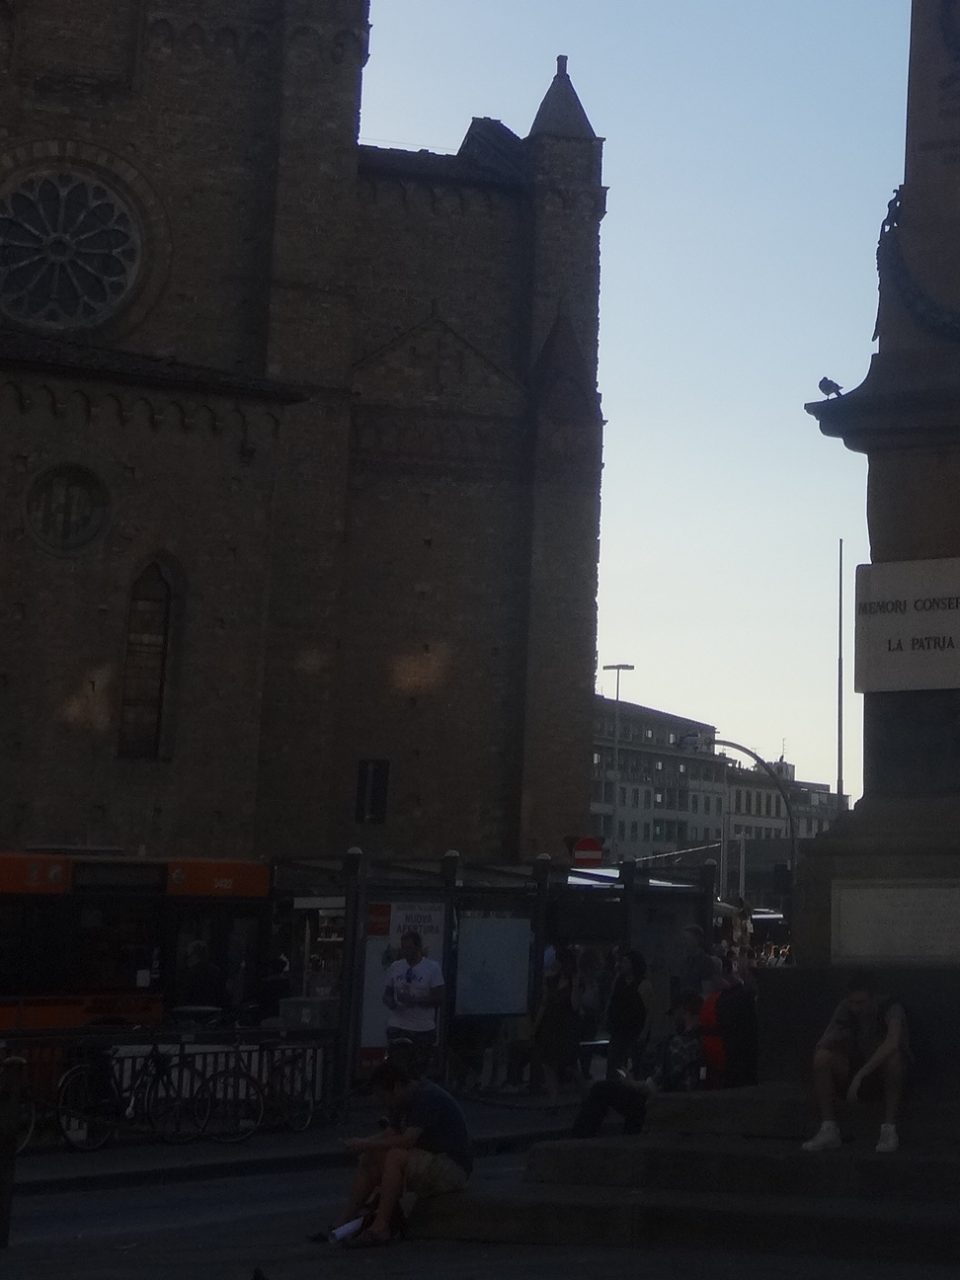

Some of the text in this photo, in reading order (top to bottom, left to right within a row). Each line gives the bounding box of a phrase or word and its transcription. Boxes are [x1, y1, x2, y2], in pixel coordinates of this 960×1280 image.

[858, 600, 907, 616] MEMORI
[887, 639, 904, 652] LA
[911, 635, 956, 652] PATRIA
[405, 913, 432, 924] NUOVA
